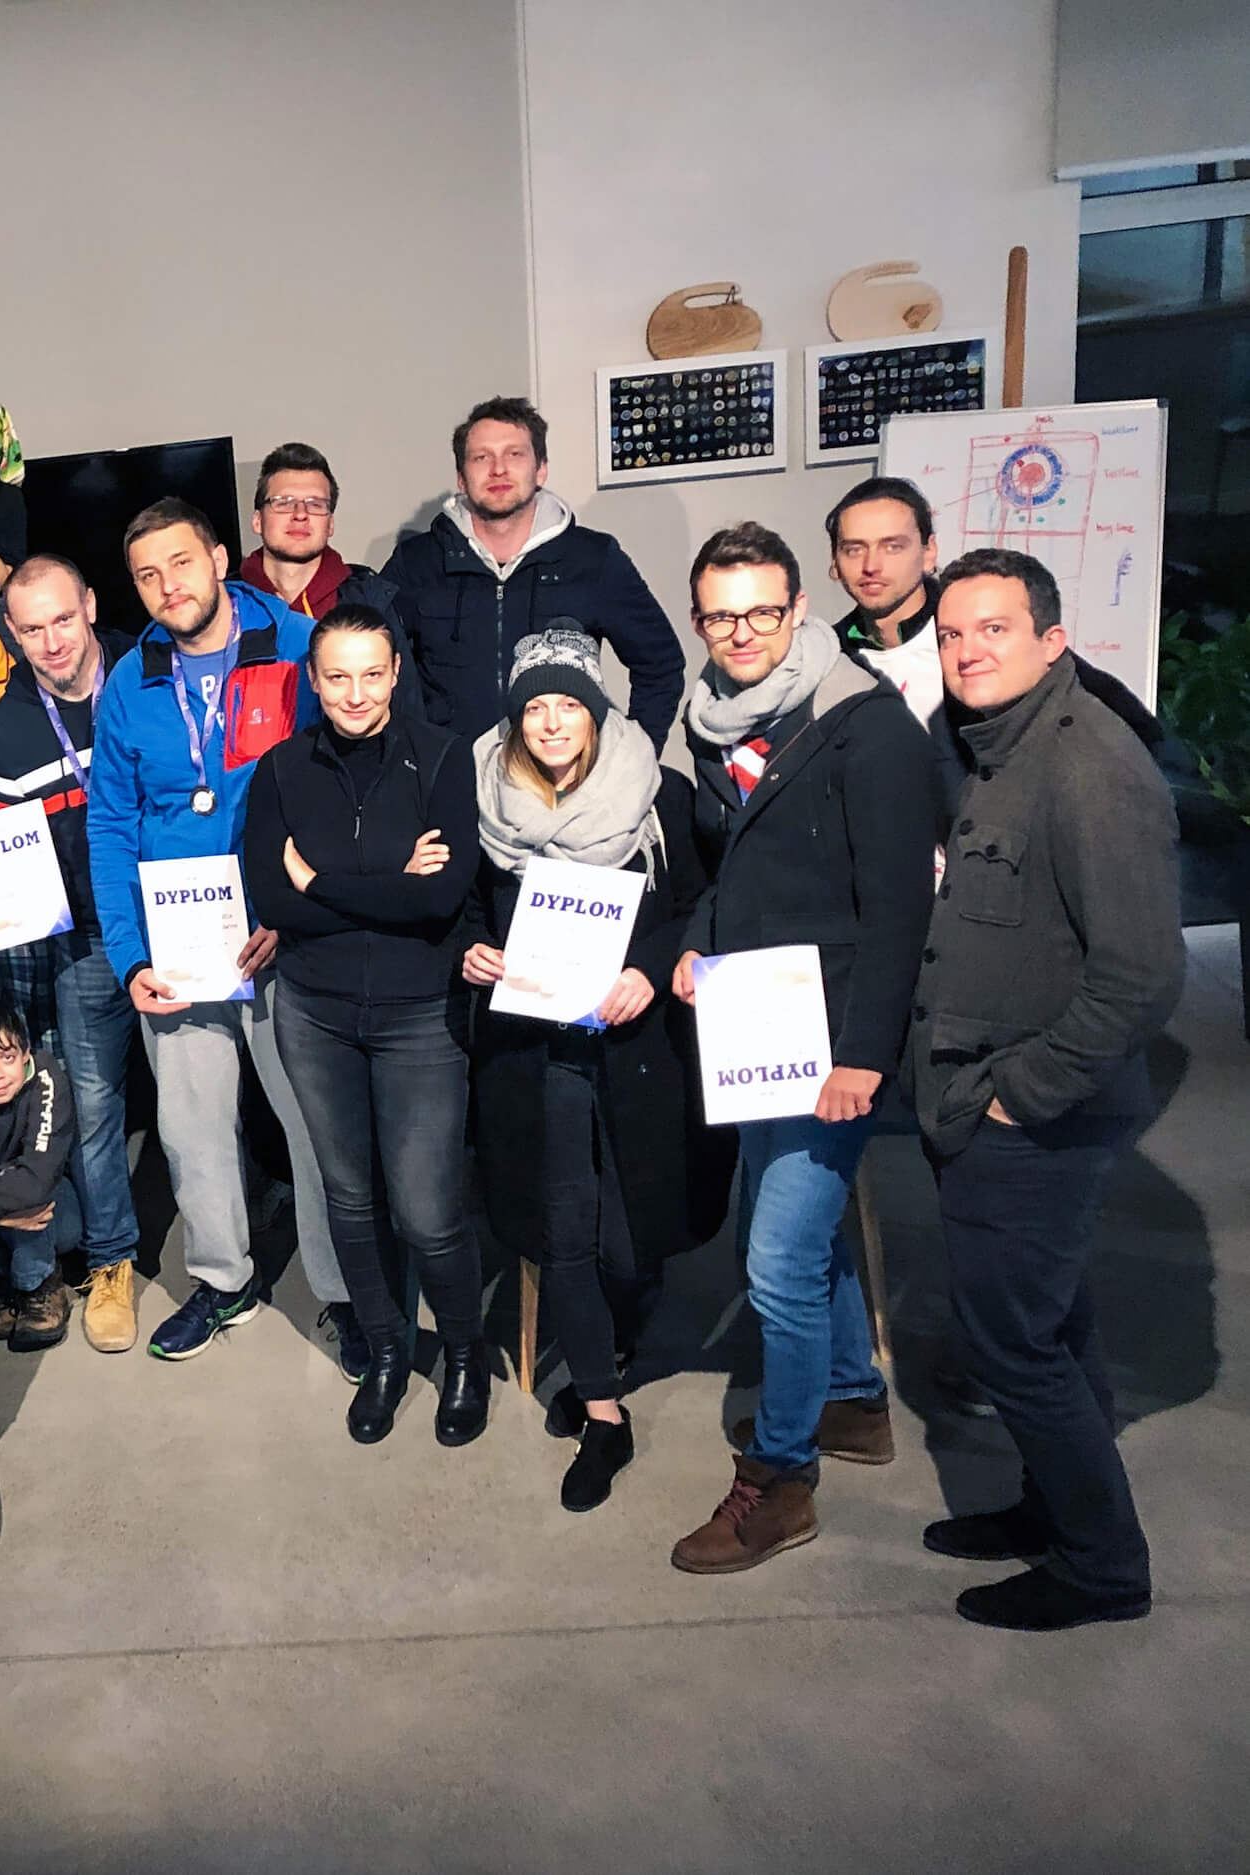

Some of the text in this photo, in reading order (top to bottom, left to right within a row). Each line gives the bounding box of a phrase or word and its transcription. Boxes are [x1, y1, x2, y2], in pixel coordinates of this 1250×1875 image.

[154, 885, 233, 906] DYPLOM
[530, 891, 624, 920] DYPLOM
[717, 1060, 818, 1086] DYPLOM
